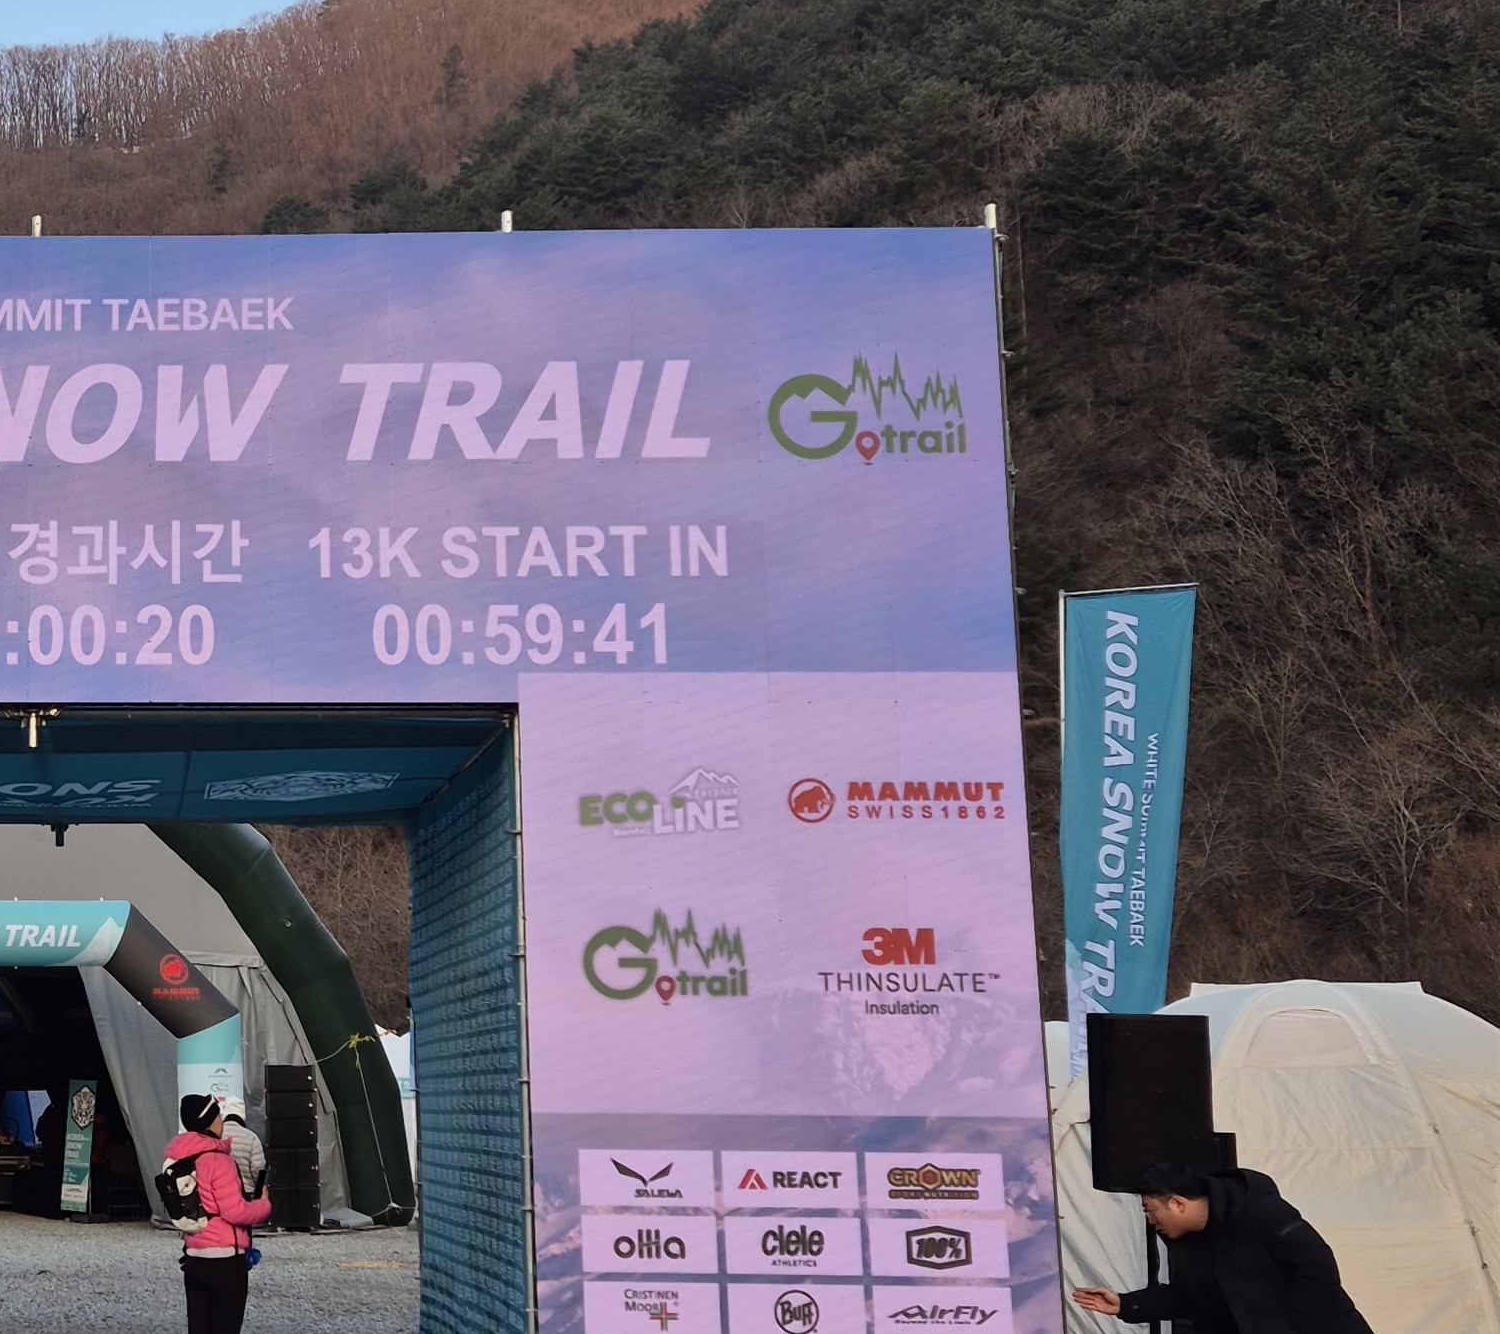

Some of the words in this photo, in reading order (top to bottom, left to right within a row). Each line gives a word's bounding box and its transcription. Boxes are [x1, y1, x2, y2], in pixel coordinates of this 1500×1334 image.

[102, 297, 295, 331] TAEBAEK
[338, 359, 711, 462] TRAIL
[8, 519, 249, 586] 경과시간
[308, 526, 421, 579] 13K
[442, 524, 626, 578] START
[670, 524, 729, 578] IN
[373, 603, 669, 666] 00:59:41
[1103, 610, 1139, 768] KOREA
[1141, 732, 1159, 790] WHITE
[847, 781, 1005, 803] MAMMUT
[1094, 777, 1134, 931] SNOW
[1128, 866, 1147, 948] TAEBAEK
[5, 925, 82, 948] TRAIL
[861, 927, 936, 966] 3M
[865, 1000, 940, 1017] Insulation
[634, 1189, 683, 1198] SALEWA
[773, 1170, 842, 1189] REACT
[887, 1164, 980, 1190] CROWN
[916, 1237, 963, 1259] 100%
